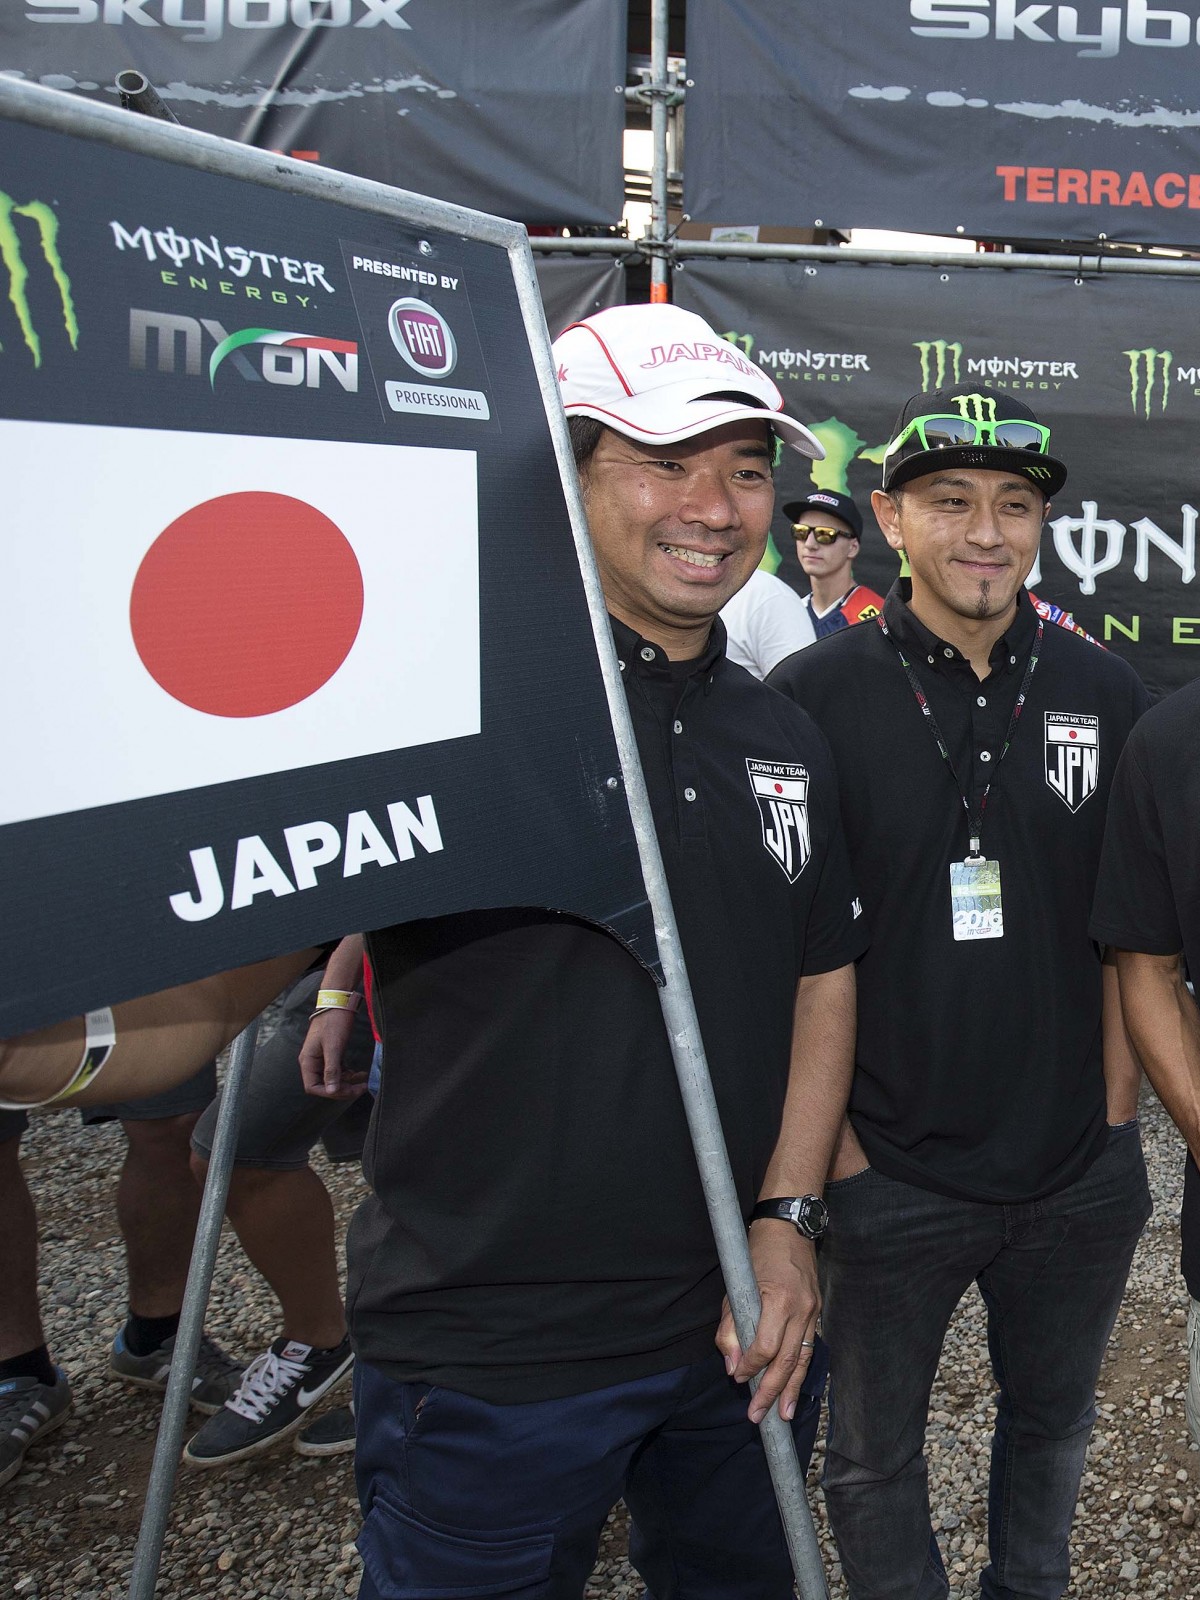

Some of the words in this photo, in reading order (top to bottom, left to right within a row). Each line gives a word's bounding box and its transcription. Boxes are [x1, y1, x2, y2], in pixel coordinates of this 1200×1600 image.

[109, 220, 336, 294] MONSTER
[353, 256, 438, 286] PRESENTED
[441, 275, 459, 290] BY
[160, 270, 312, 308] ENERGY
[403, 319, 443, 357] FIAT
[640, 343, 766, 381] JAPAN
[758, 348, 871, 372] MONSTER
[967, 356, 1080, 379] MONSTER
[775, 371, 854, 382] ENERGY
[984, 379, 1063, 390] ENERGY
[395, 389, 482, 411] PROFESSIONAL
[1048, 714, 1069, 722] JAPAN
[1080, 717, 1097, 725] TEAM
[750, 763, 772, 774] JAPAN
[773, 766, 785, 775] MX
[785, 767, 806, 777] TEAM
[1048, 745, 1097, 806] JPN
[766, 800, 809, 875] JPN
[169, 795, 444, 922] JAPAN
[954, 908, 1002, 927] 2016
